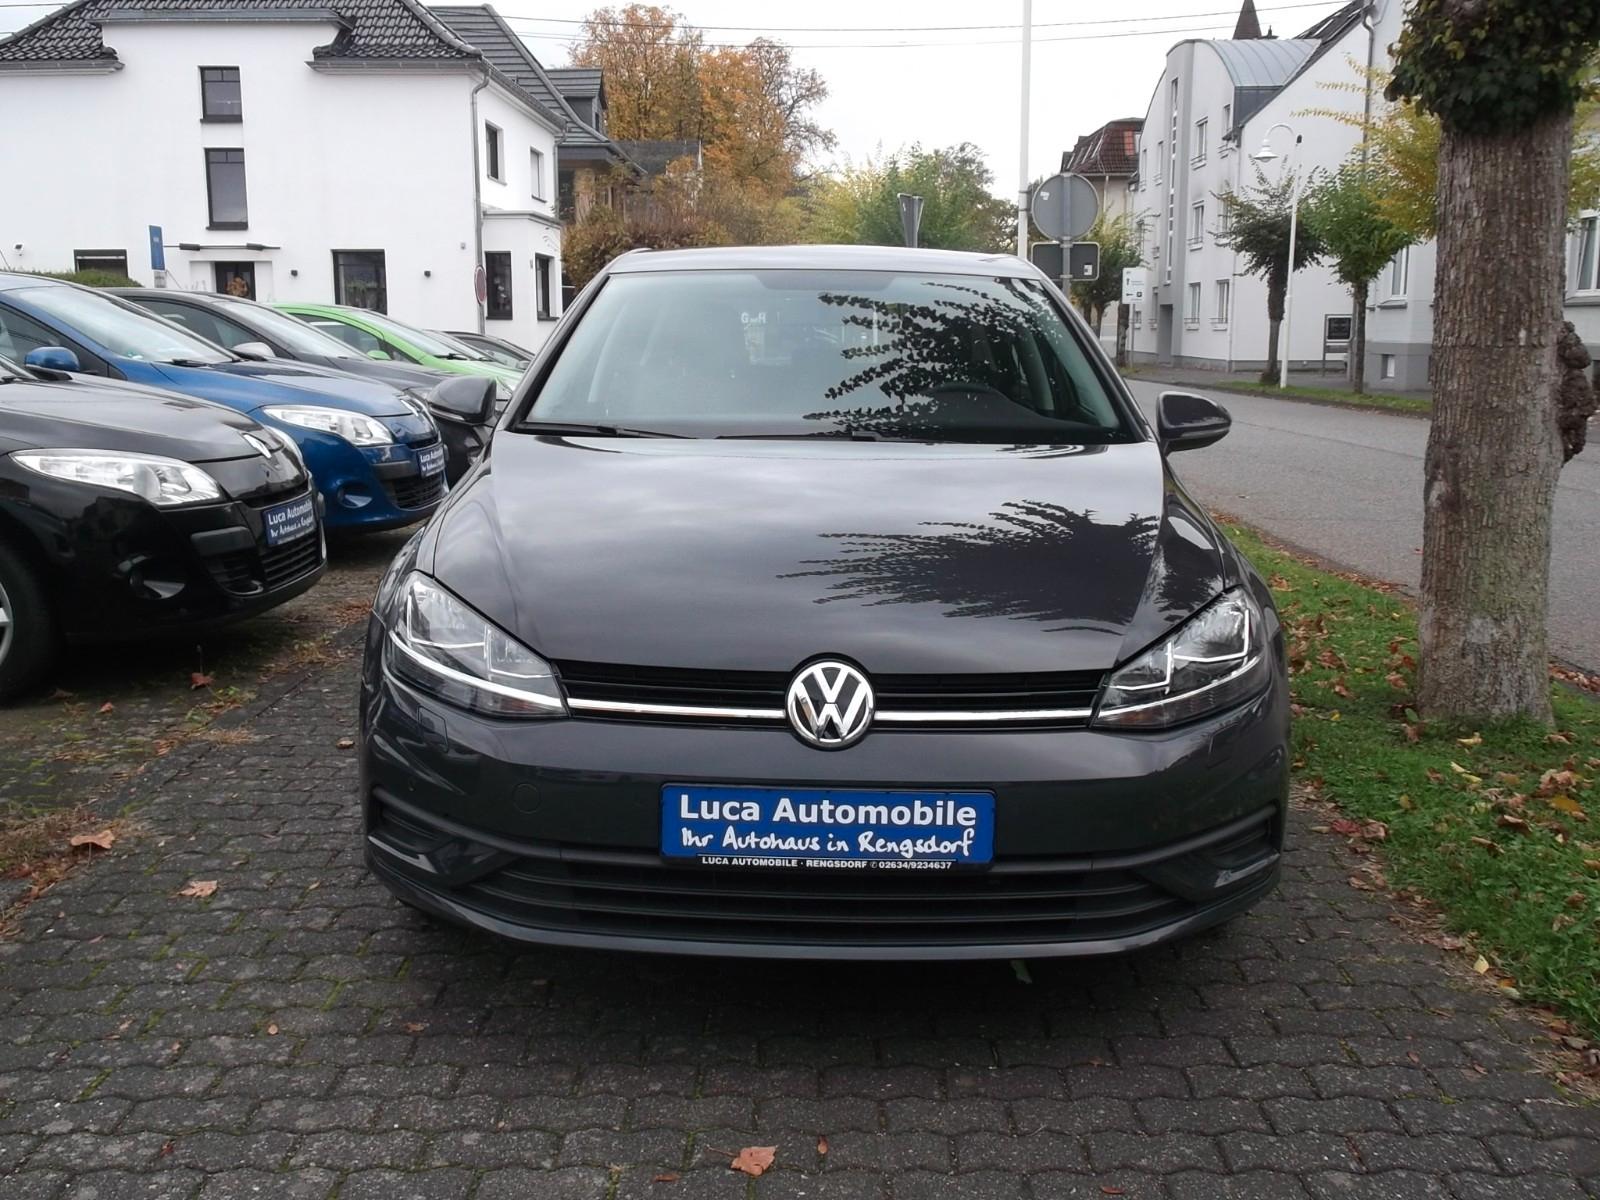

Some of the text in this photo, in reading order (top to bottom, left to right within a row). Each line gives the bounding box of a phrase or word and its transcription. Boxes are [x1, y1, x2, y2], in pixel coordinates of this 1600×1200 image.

[268, 512, 286, 525] Luca
[786, 661, 875, 746] VW
[680, 794, 977, 826] Luca Automobile
[681, 825, 975, 859] Ihr Autohaus in Rengsdorf
[702, 856, 952, 870] LUCA AUTOMOBILE RENGSDORF 02634/9234637
